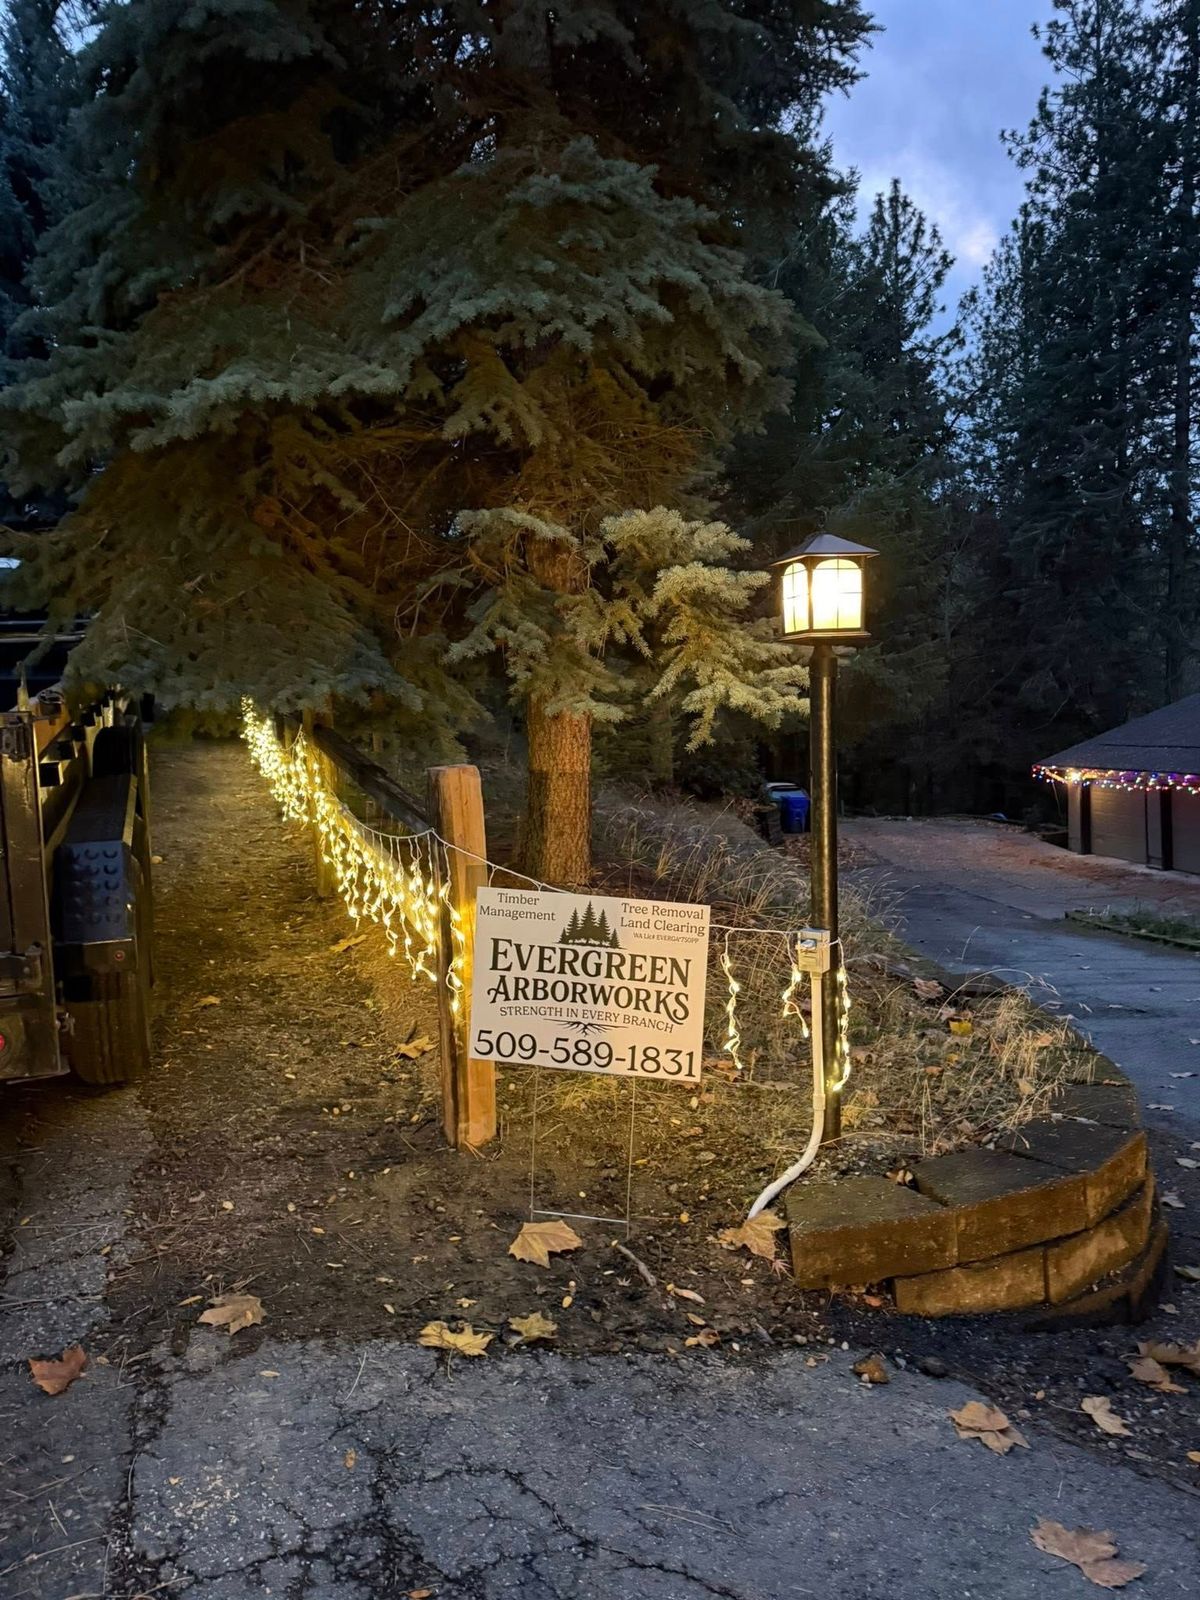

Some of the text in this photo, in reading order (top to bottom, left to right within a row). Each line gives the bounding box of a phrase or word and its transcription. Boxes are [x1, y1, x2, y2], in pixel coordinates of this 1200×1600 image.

[497, 893, 539, 905] Timber
[480, 905, 556, 920] Management
[621, 903, 704, 919] Tree Removal
[620, 917, 705, 936] Land Clearing
[489, 937, 692, 987] EVERGREEN
[487, 975, 689, 1025] ARBORWORKS
[500, 1006, 674, 1033] STRENGTH IN EVERY BRANCH
[474, 1029, 696, 1078] 509-589-1831
